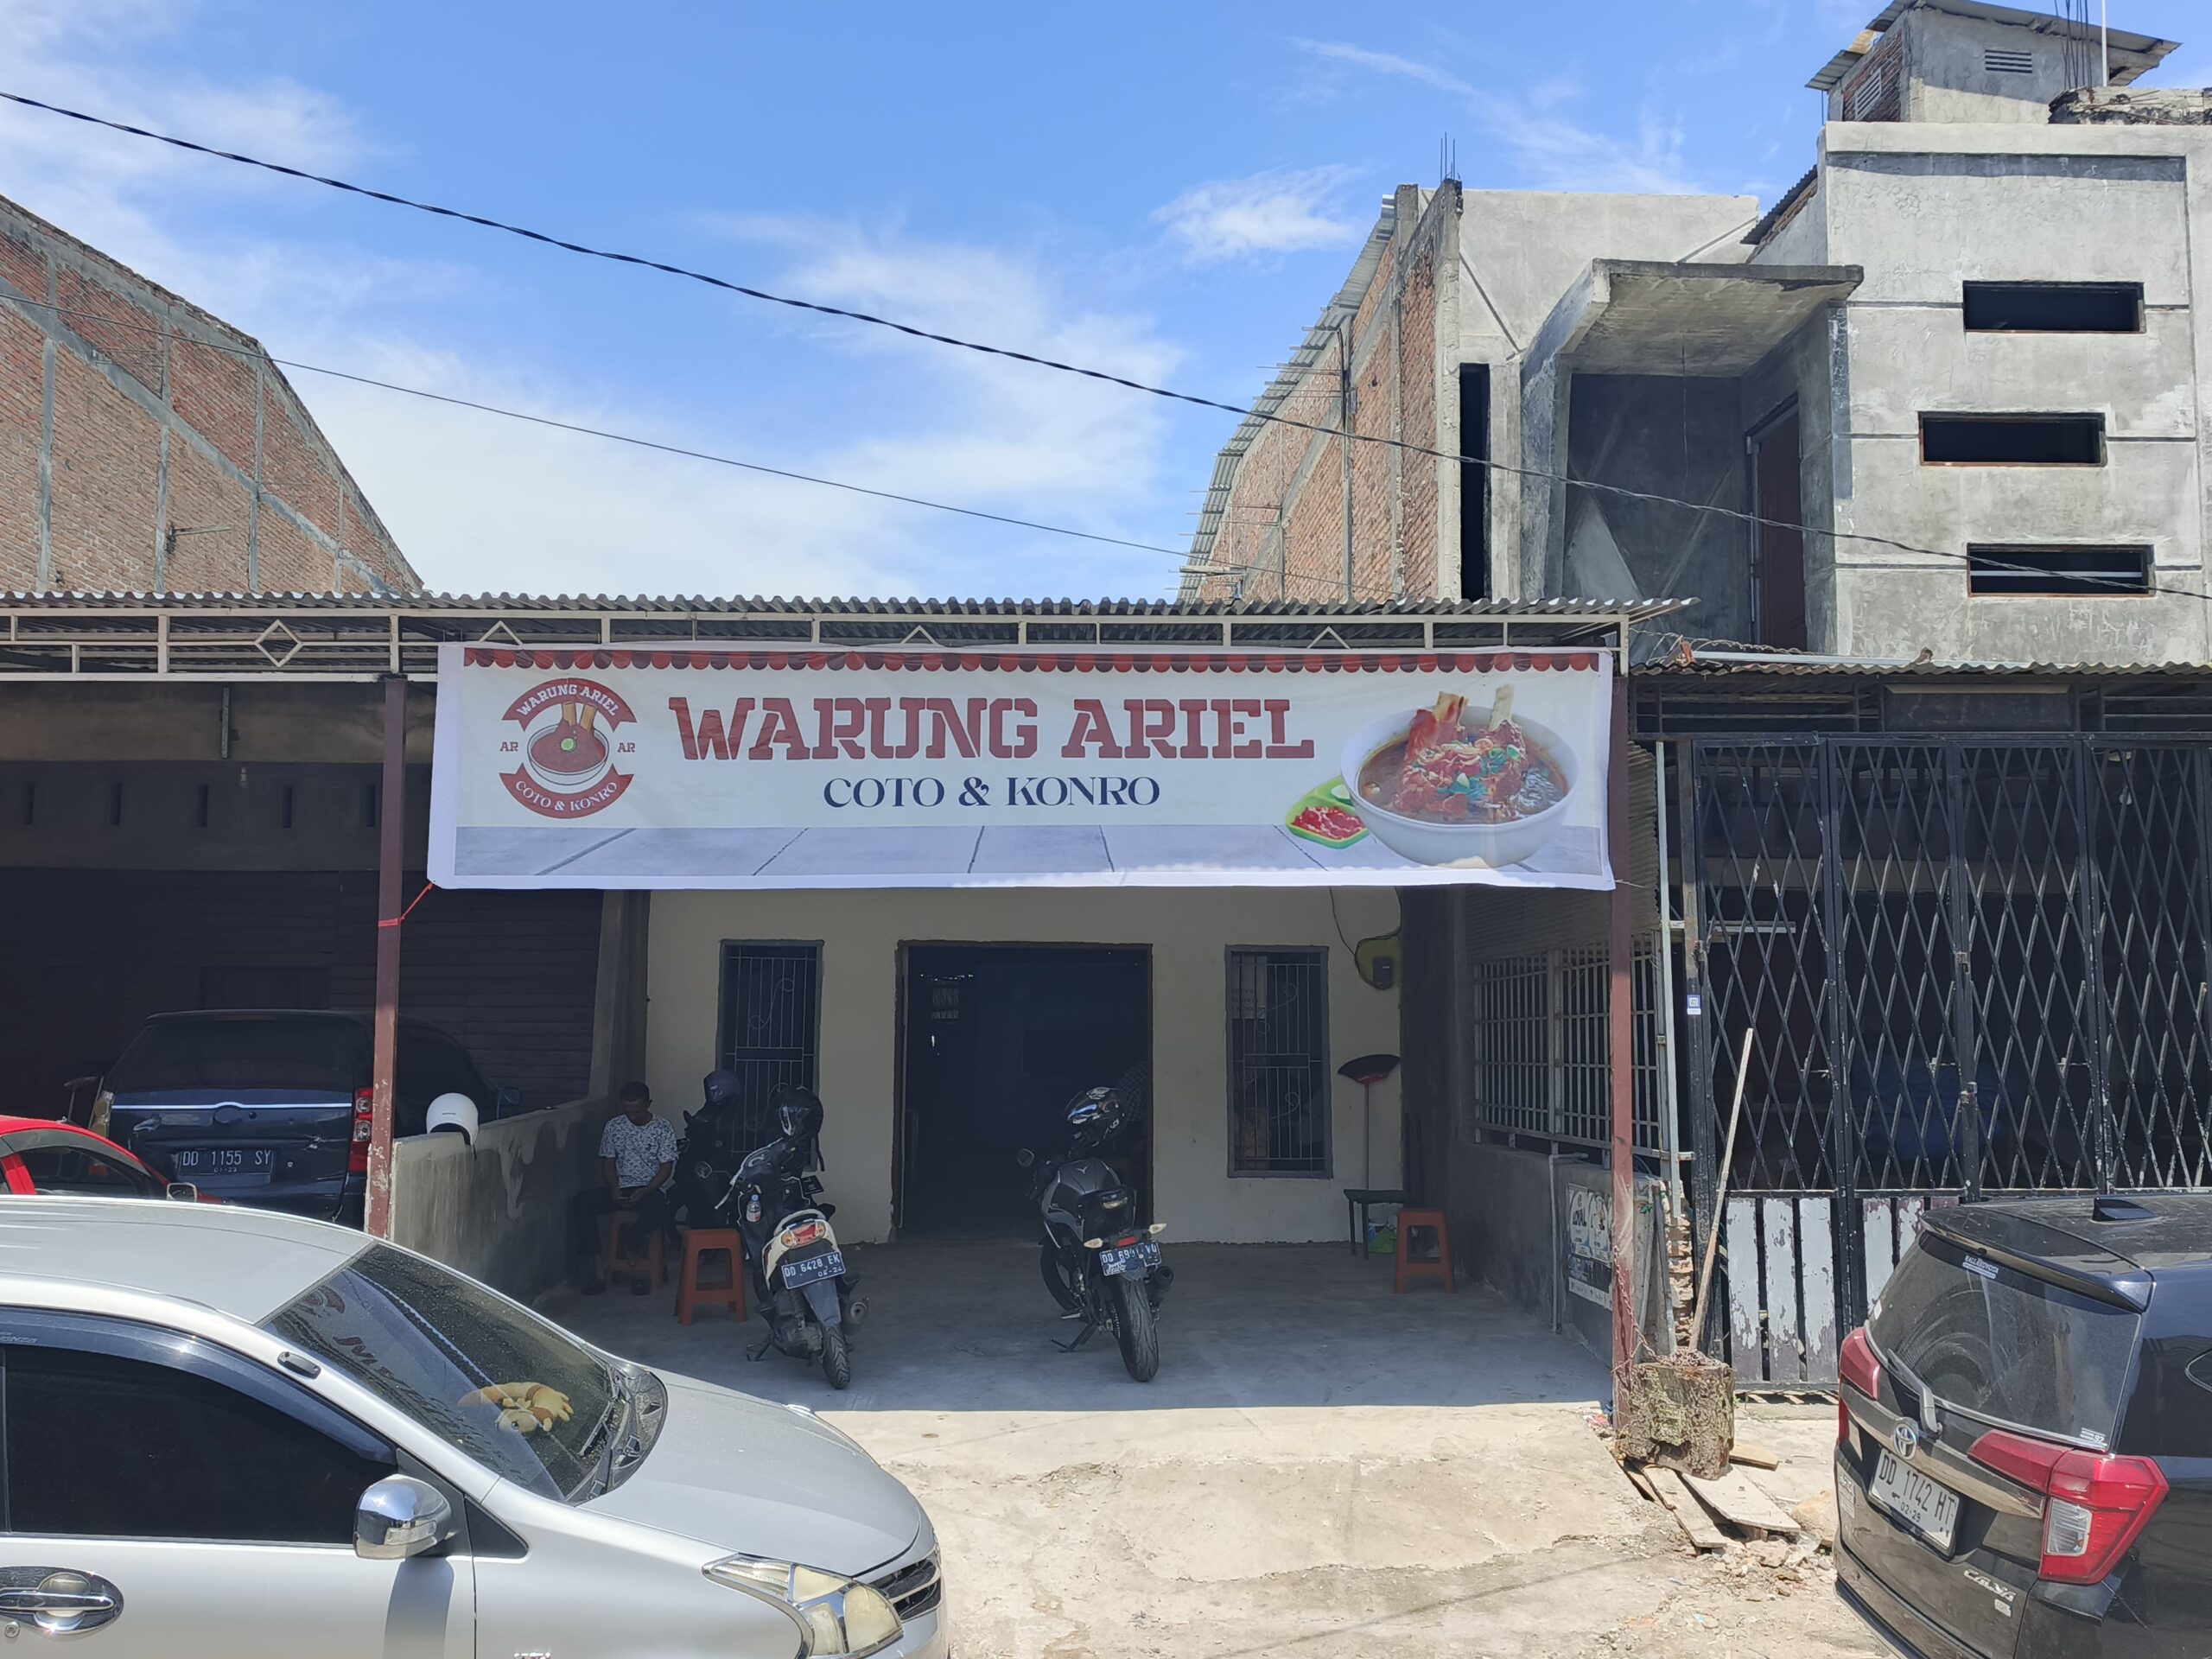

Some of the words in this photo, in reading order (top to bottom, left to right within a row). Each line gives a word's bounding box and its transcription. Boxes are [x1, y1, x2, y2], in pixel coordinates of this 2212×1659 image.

[517, 684, 577, 715] WARUNG
[580, 686, 620, 715] ARIEL
[669, 696, 1038, 760] WARUNG
[1061, 698, 1314, 760] ARIEL
[499, 741, 518, 752] AR
[617, 742, 636, 753] AR
[516, 780, 551, 808] COTO
[555, 801, 565, 810] &
[570, 782, 617, 811] KONRO
[823, 778, 944, 808] COTO
[958, 777, 991, 806] &
[1006, 777, 1160, 806] KONRO
[182, 1151, 199, 1166] DD
[212, 1150, 242, 1166] 1155
[255, 1149, 271, 1165] SY
[784, 1266, 796, 1277] DD
[800, 1258, 823, 1272] 6428
[827, 1254, 840, 1264] EK
[1878, 1454, 1897, 1485] DD
[1904, 1470, 1932, 1512] 1742
[1964, 1569, 2016, 1602] CALYA
